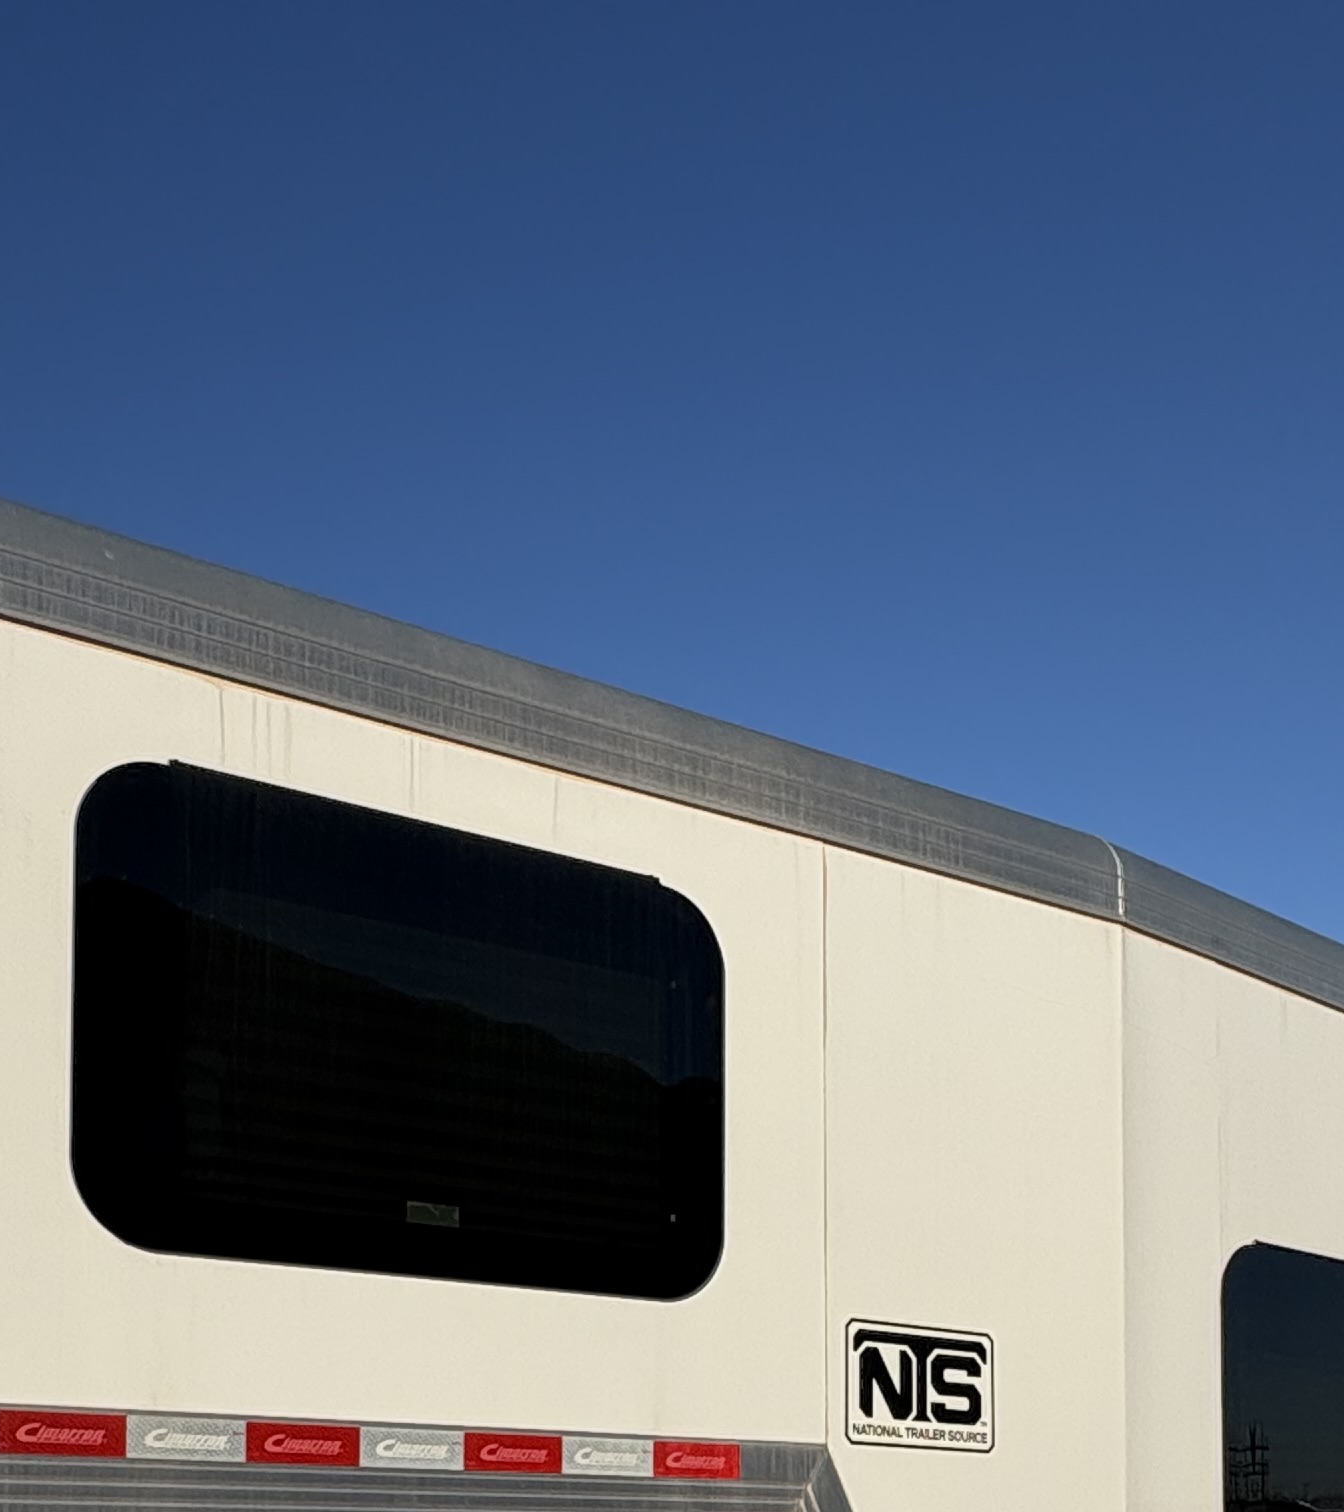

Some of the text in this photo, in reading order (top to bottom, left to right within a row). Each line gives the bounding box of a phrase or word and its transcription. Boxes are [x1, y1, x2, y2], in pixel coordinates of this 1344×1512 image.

[853, 1328, 988, 1426] NTS
[16, 1422, 105, 1446] Cimarron
[144, 1428, 230, 1450] Cimarron
[264, 1433, 344, 1456] Cimarron
[853, 1422, 988, 1444] NATIONAL TRAILER SOURCE
